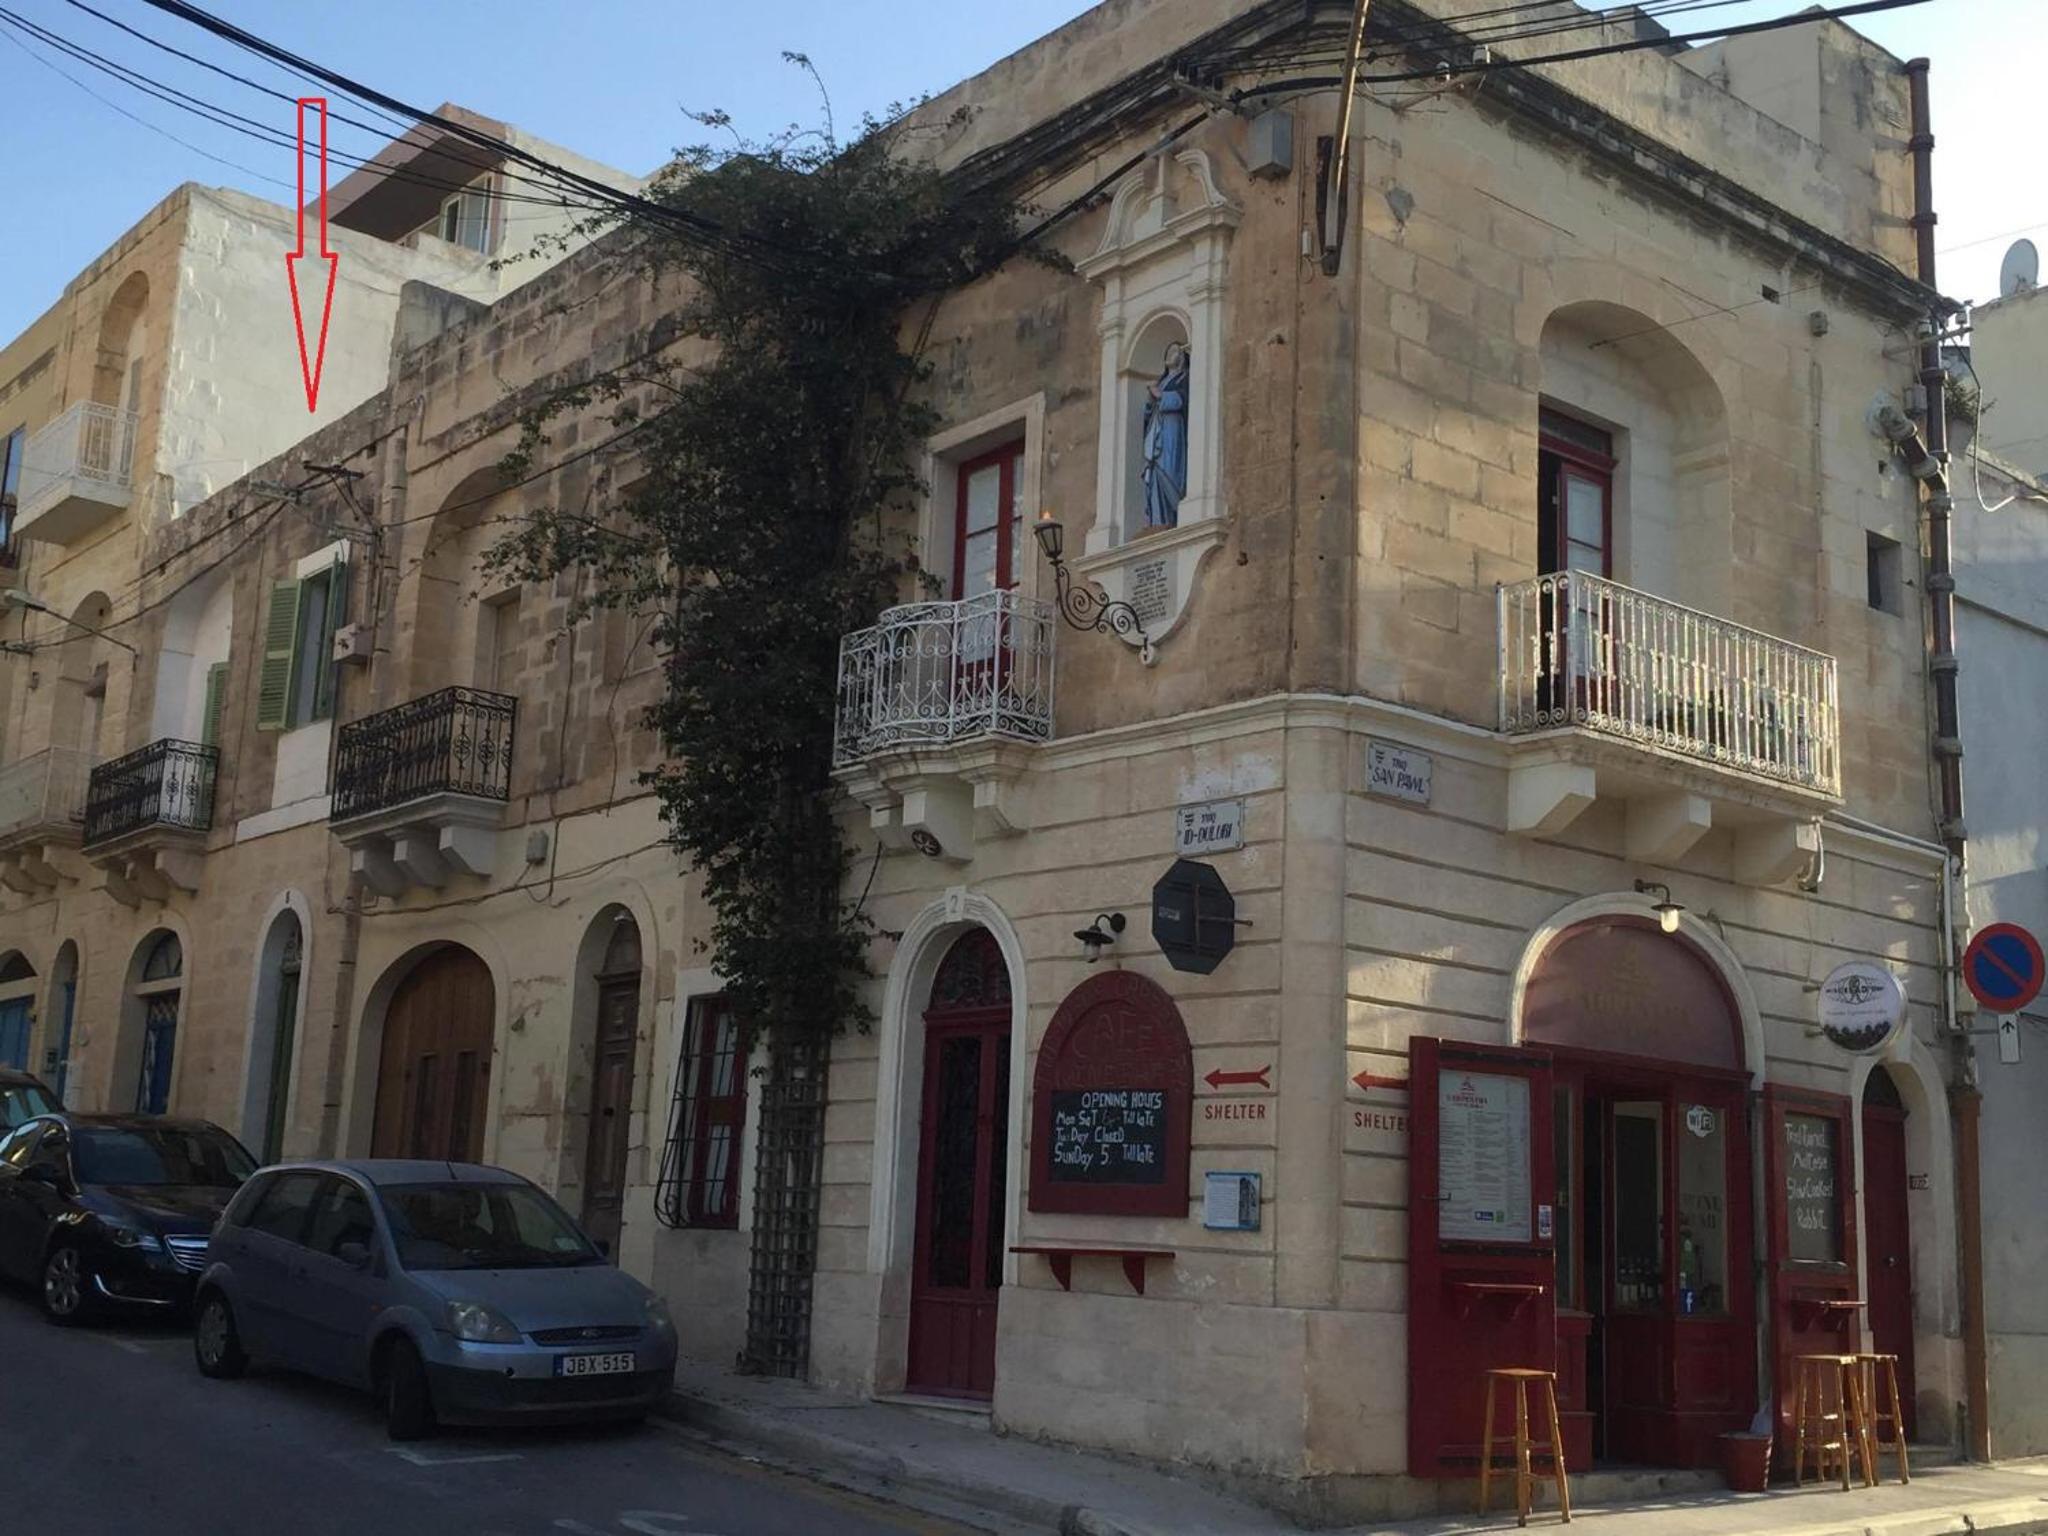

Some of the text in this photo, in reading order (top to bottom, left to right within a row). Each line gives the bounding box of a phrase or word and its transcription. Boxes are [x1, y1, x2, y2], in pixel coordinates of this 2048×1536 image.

[1372, 766, 1425, 794] SAN PAWL
[1081, 1091, 1127, 1109] OPENING
[1204, 1103, 1267, 1121] SHELTER
[1353, 1110, 1410, 1132] SHELTE
